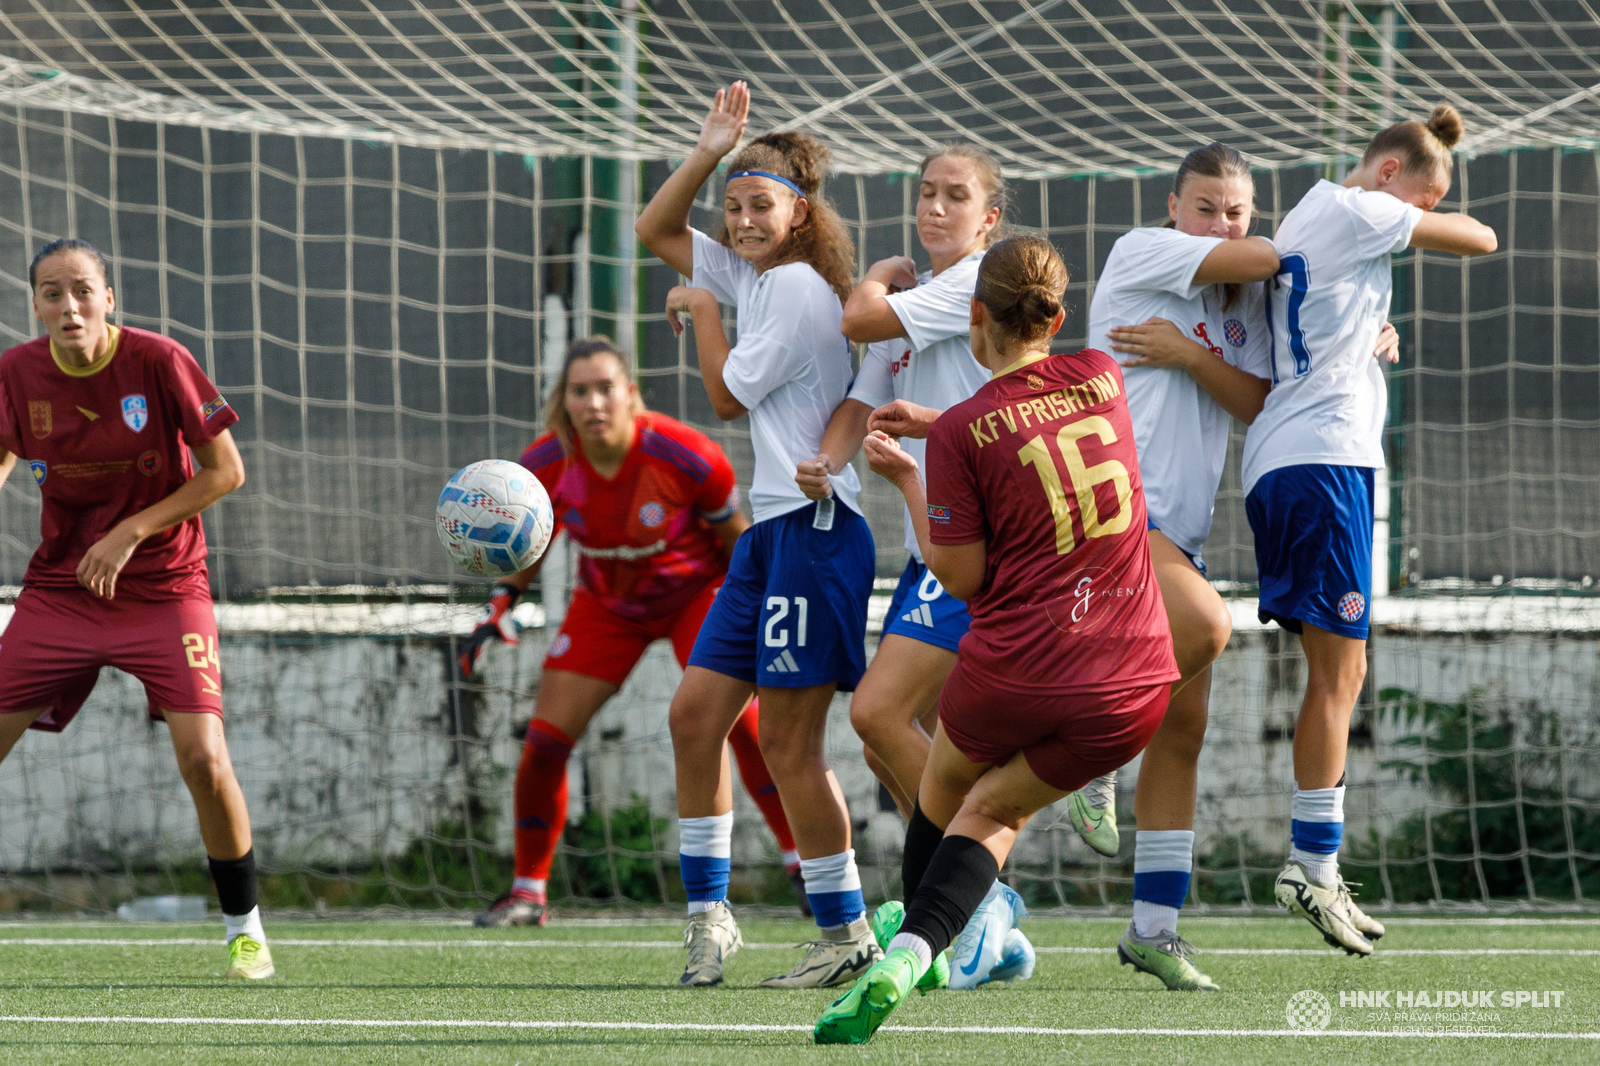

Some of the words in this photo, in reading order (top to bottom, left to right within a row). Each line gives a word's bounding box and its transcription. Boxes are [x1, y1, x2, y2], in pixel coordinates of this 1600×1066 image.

[968, 405, 1018, 448] KFV
[1019, 370, 1121, 428] PRISHTINA
[1016, 415, 1133, 555] 16
[181, 632, 222, 674] 24
[764, 595, 808, 648] 21
